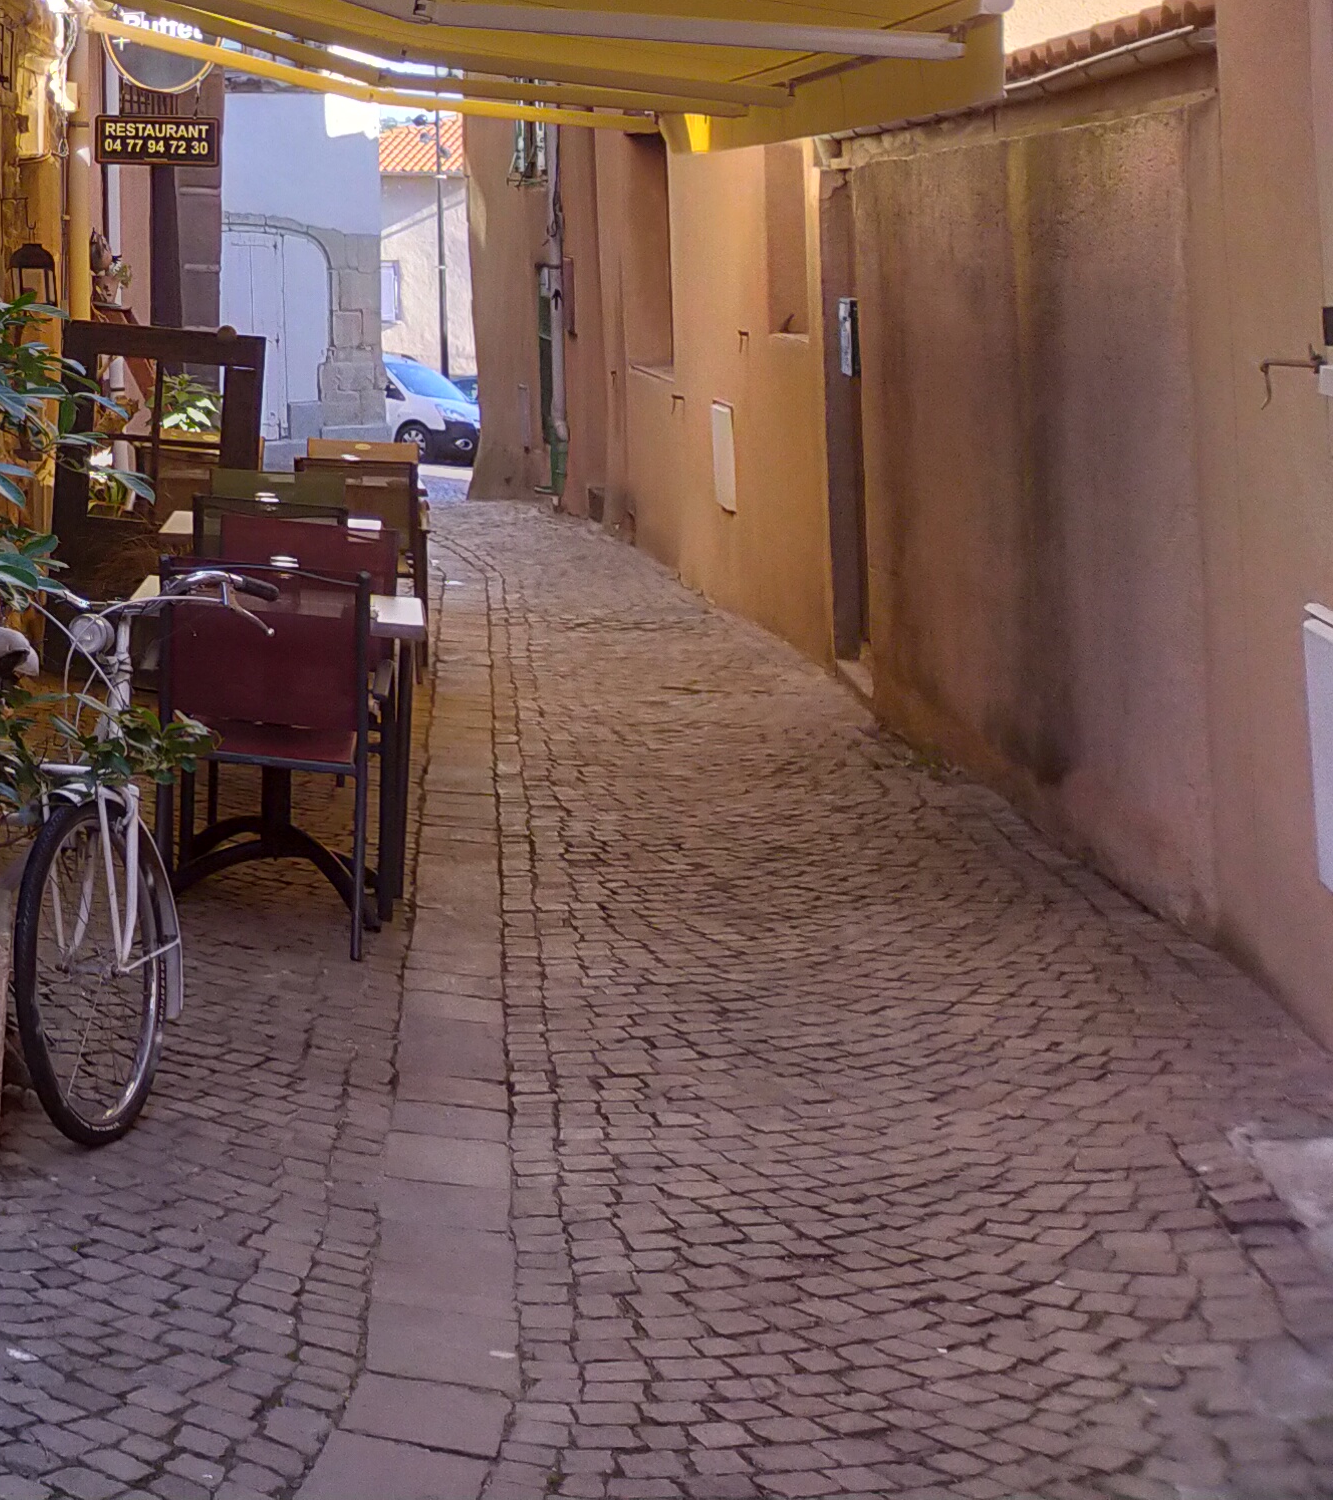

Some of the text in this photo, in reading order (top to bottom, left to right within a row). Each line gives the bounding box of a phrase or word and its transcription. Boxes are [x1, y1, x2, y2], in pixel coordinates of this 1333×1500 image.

[105, 122, 209, 139] RESTAURANT
[104, 138, 209, 155] 04 77 94 72 30
